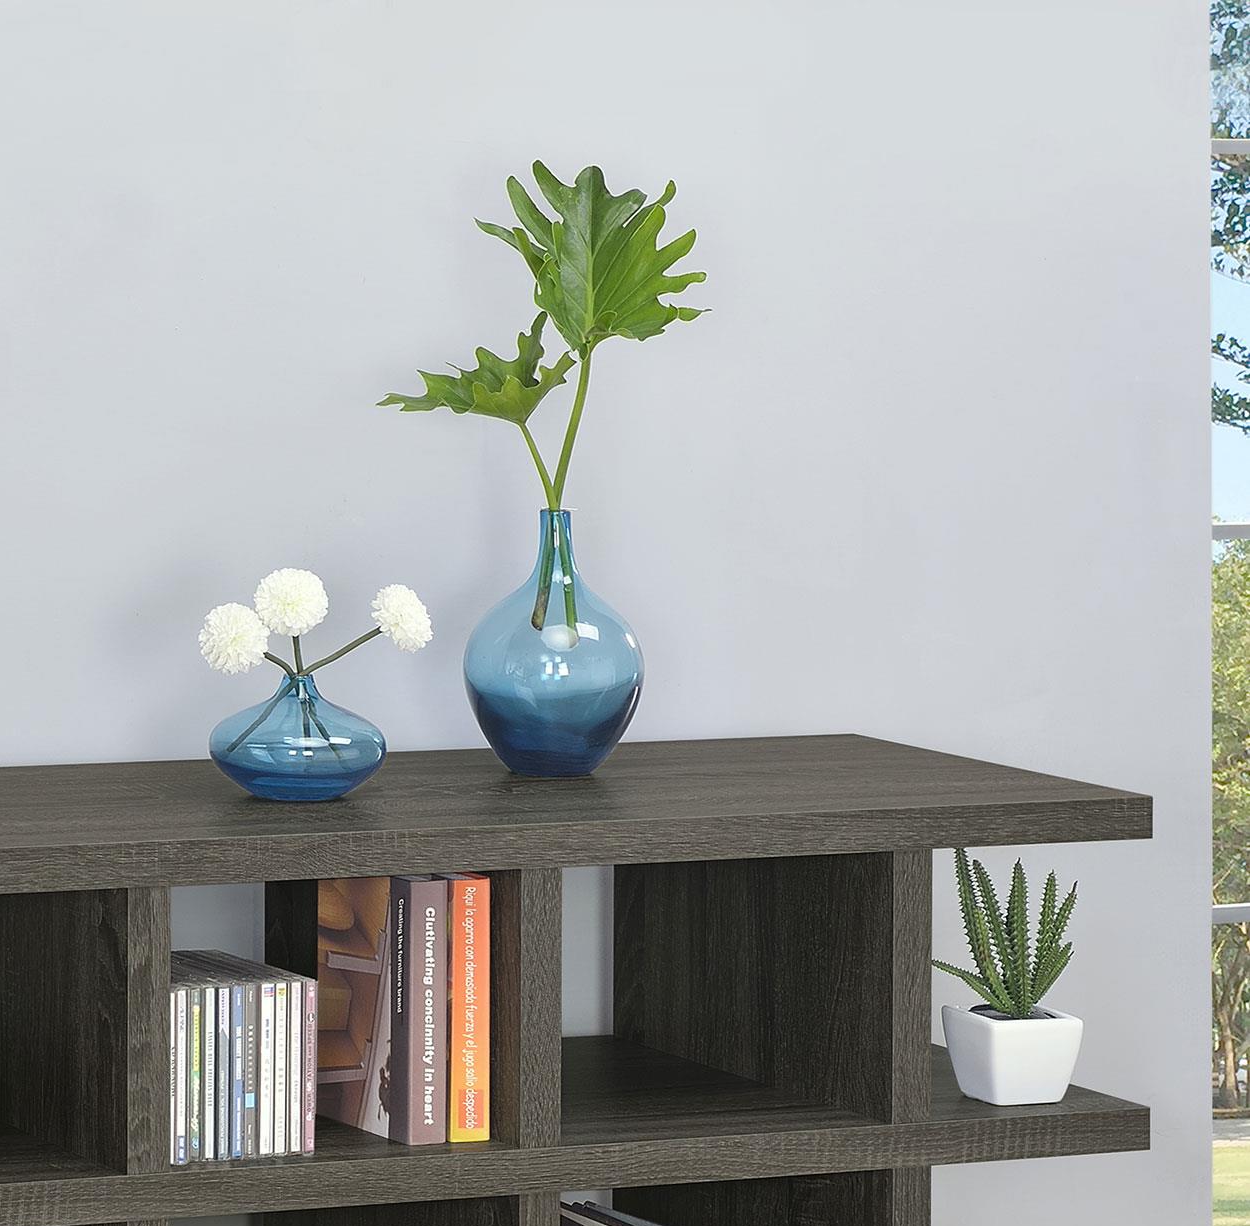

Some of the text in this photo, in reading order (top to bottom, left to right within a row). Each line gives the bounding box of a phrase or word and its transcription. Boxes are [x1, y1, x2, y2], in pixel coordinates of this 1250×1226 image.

[397, 898, 405, 935] Creating
[465, 946, 475, 960] con
[465, 1004, 478, 1032] fuerza
[424, 1068, 435, 1083] in
[424, 1086, 435, 1126] heart
